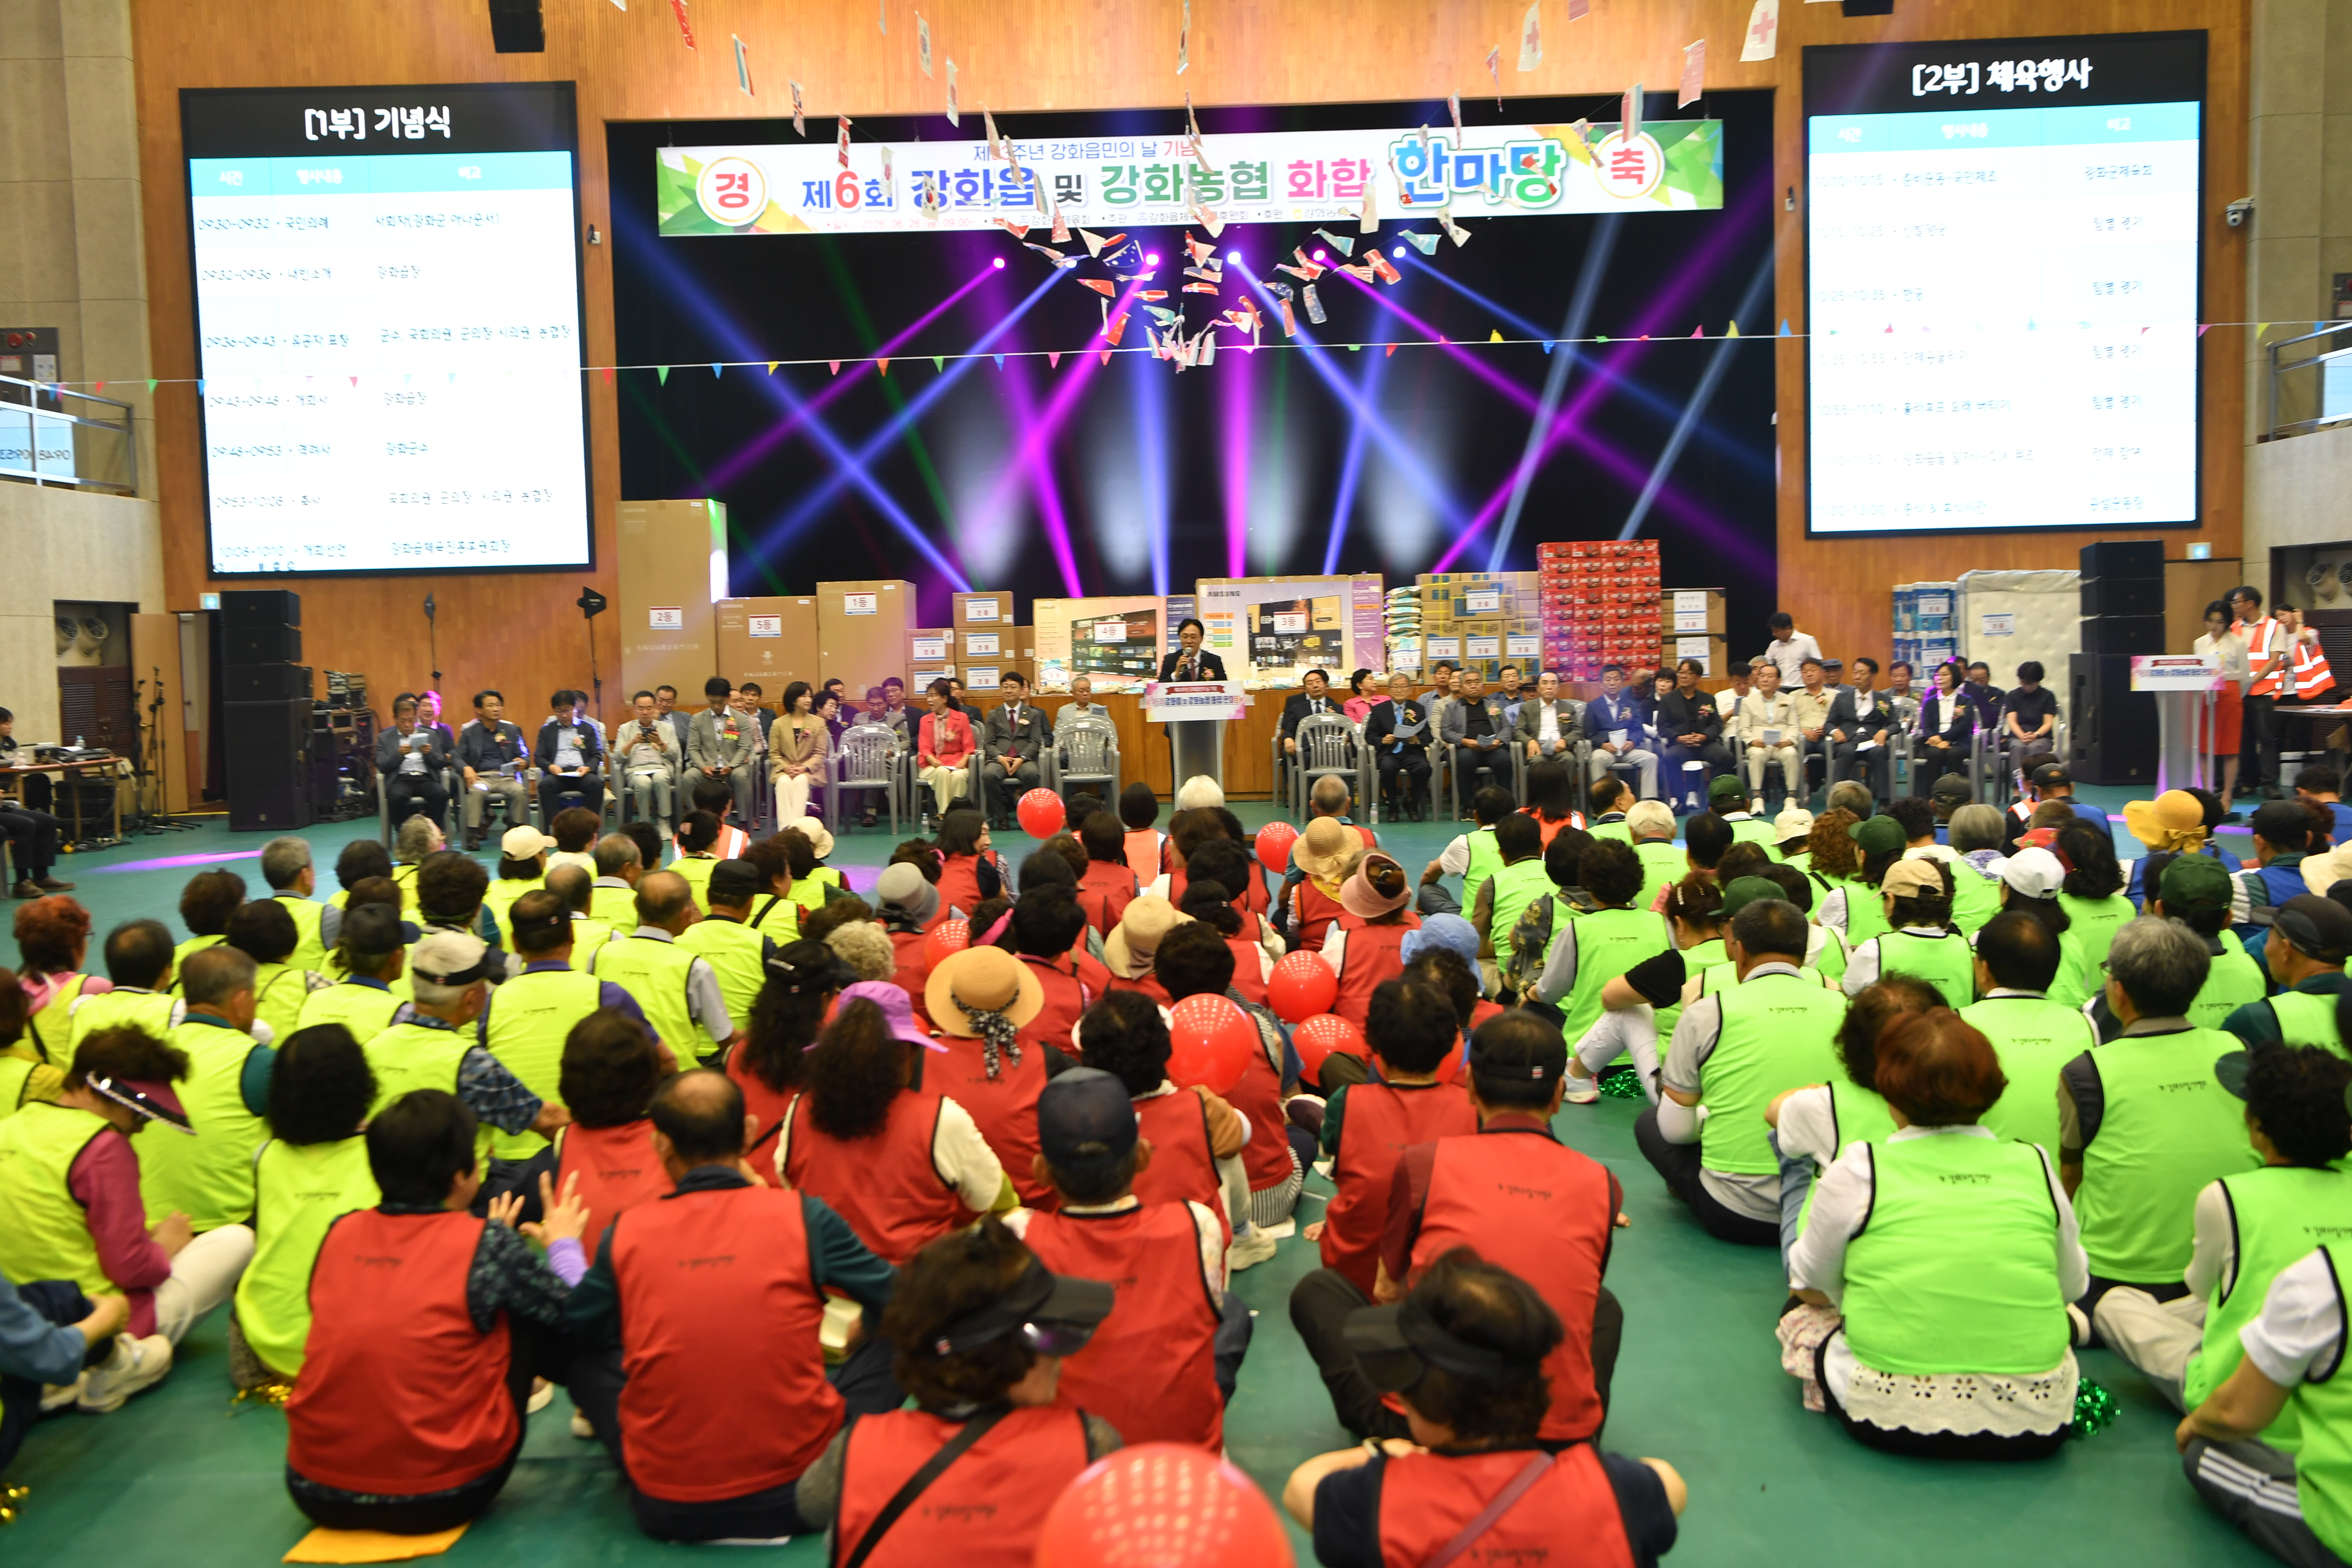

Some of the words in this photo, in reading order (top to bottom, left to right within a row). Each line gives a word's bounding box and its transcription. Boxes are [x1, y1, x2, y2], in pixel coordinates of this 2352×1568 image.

[1913, 62, 1979, 96] [2부]
[1987, 57, 2093, 92] 체육행사
[305, 108, 366, 140] [1부]
[374, 106, 450, 139] 기념식
[1051, 142, 1134, 160] 강화읍민의
[1141, 142, 1157, 158] 날
[802, 172, 893, 209] 제6회
[911, 167, 1034, 208] 강화읍
[1055, 174, 1082, 203] 및
[1100, 161, 1267, 204] 강화농협
[1287, 158, 1370, 198] 화합
[1395, 139, 1561, 203] 한마당
[1610, 148, 1646, 185] 축
[716, 173, 749, 209] 경
[852, 597, 868, 607] 1등
[657, 612, 672, 622] 2등
[757, 620, 772, 630] 5등
[1281, 617, 1296, 626] 3등
[1102, 626, 1117, 636] 4등
